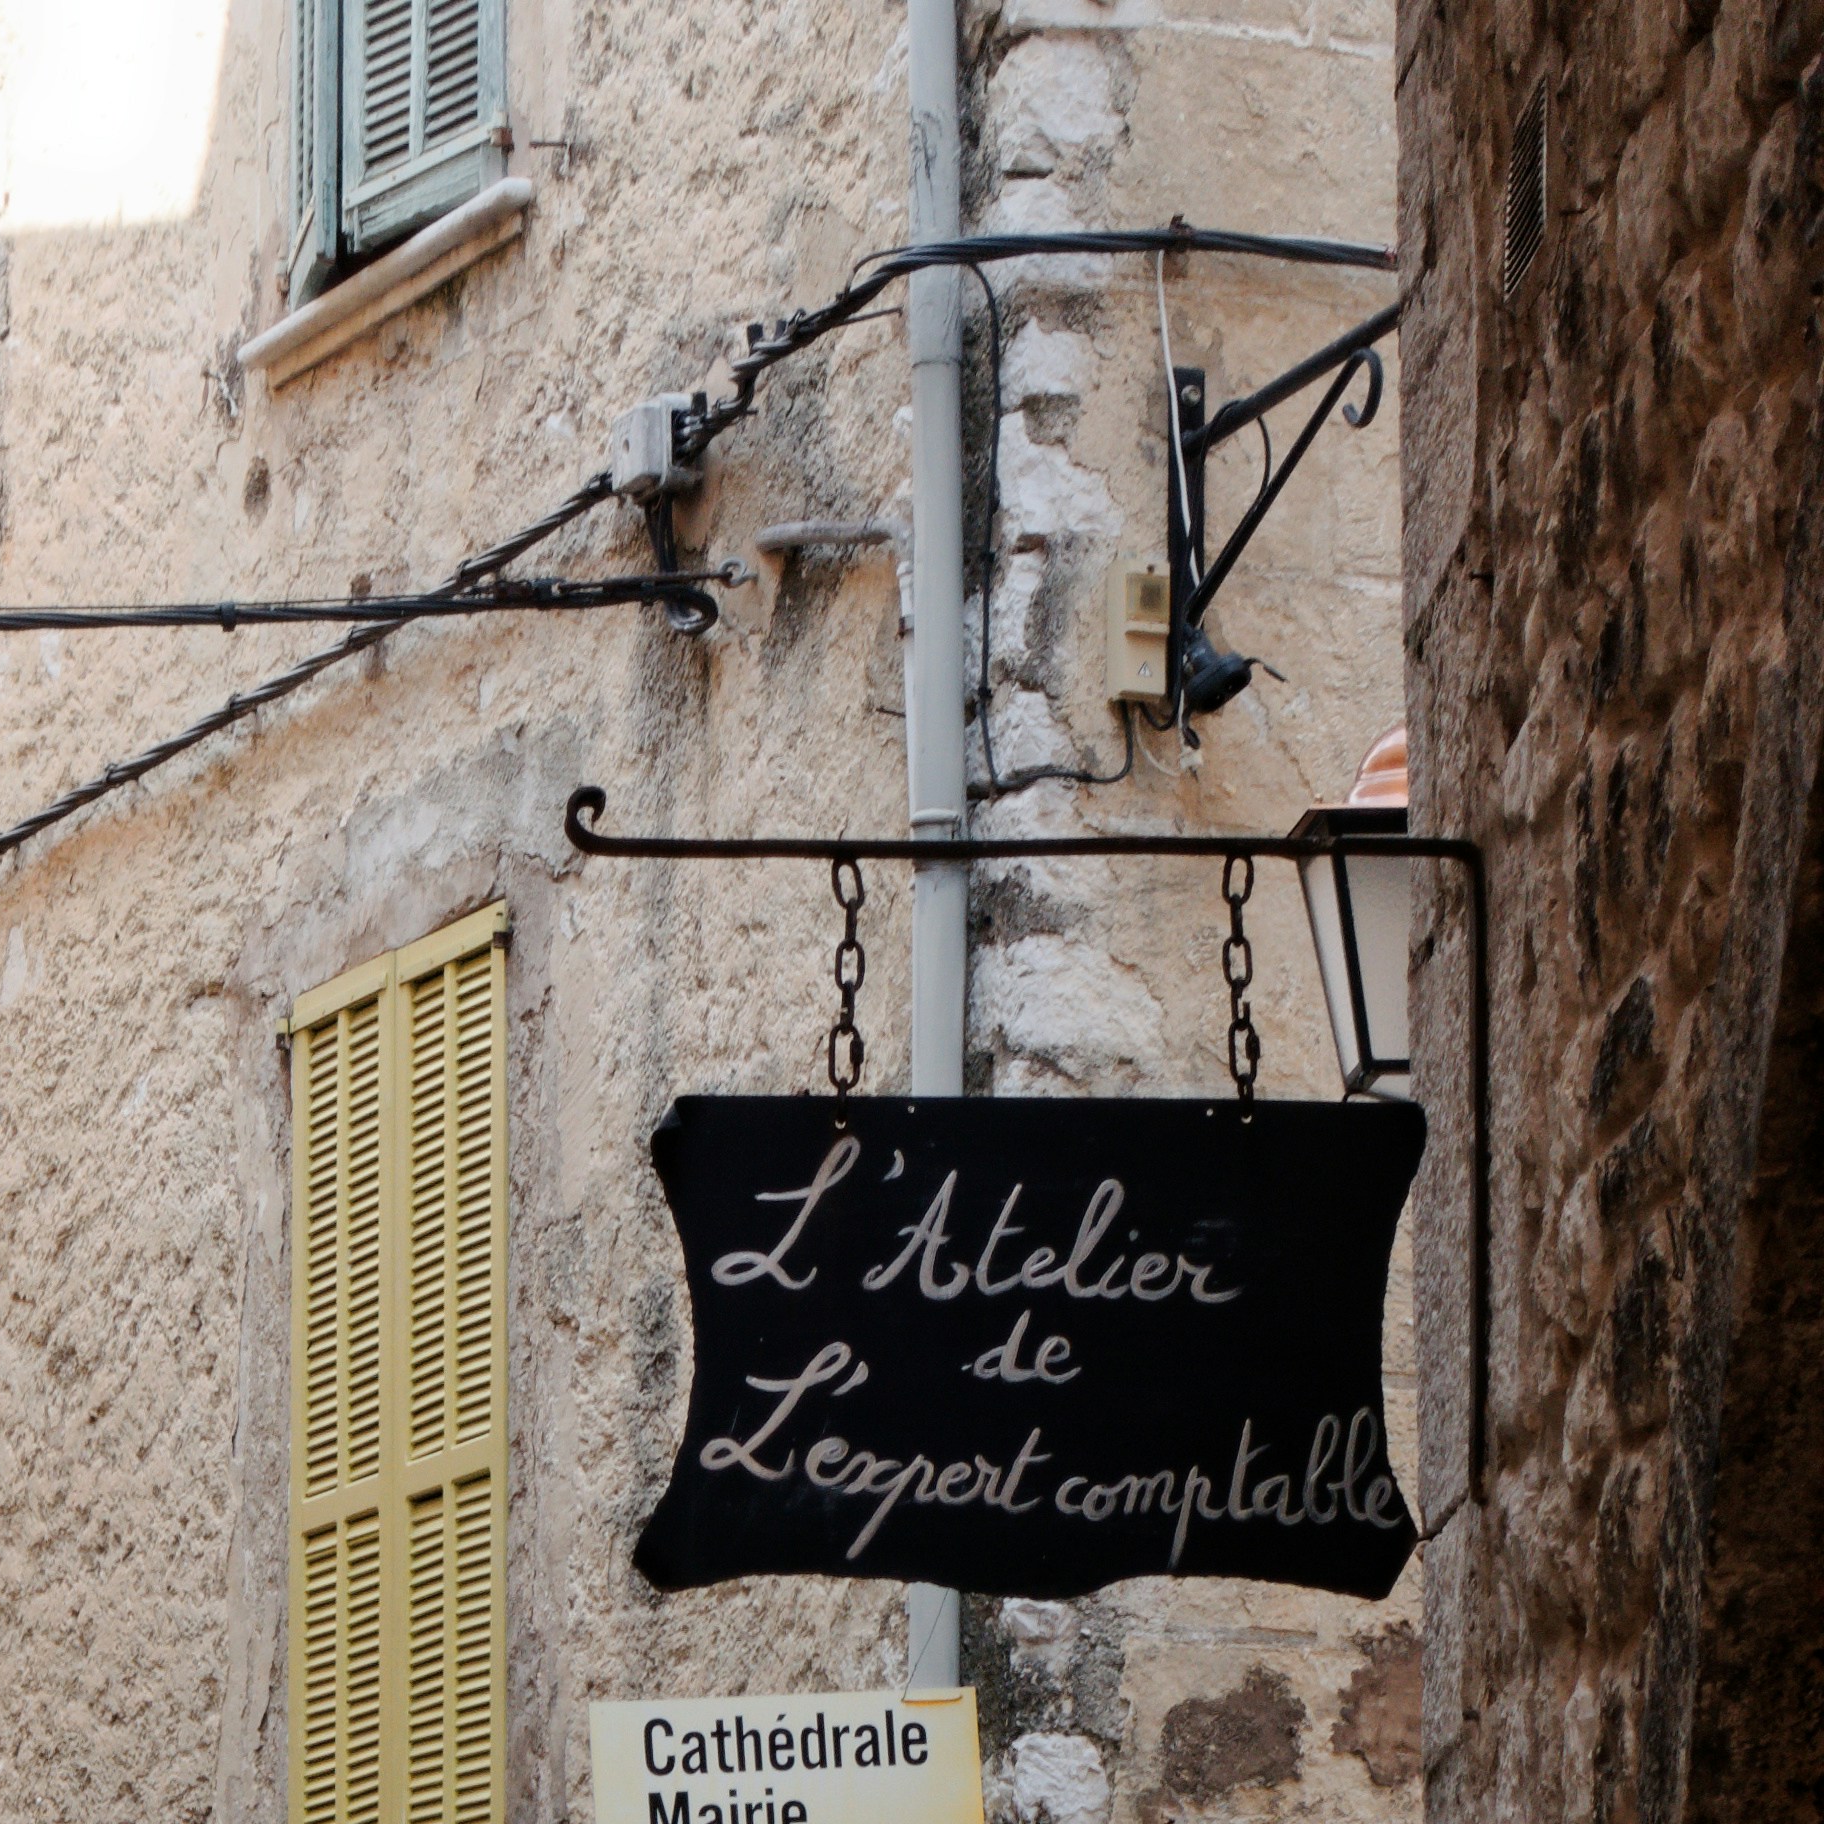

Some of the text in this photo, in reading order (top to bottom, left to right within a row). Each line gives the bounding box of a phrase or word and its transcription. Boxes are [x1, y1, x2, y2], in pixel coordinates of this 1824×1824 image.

[710, 1134, 1244, 1304] L'Atelier
[968, 1309, 1084, 1385] de
[699, 1340, 1404, 1570] L'expert comptable
[641, 1709, 931, 1777] Cathédrale
